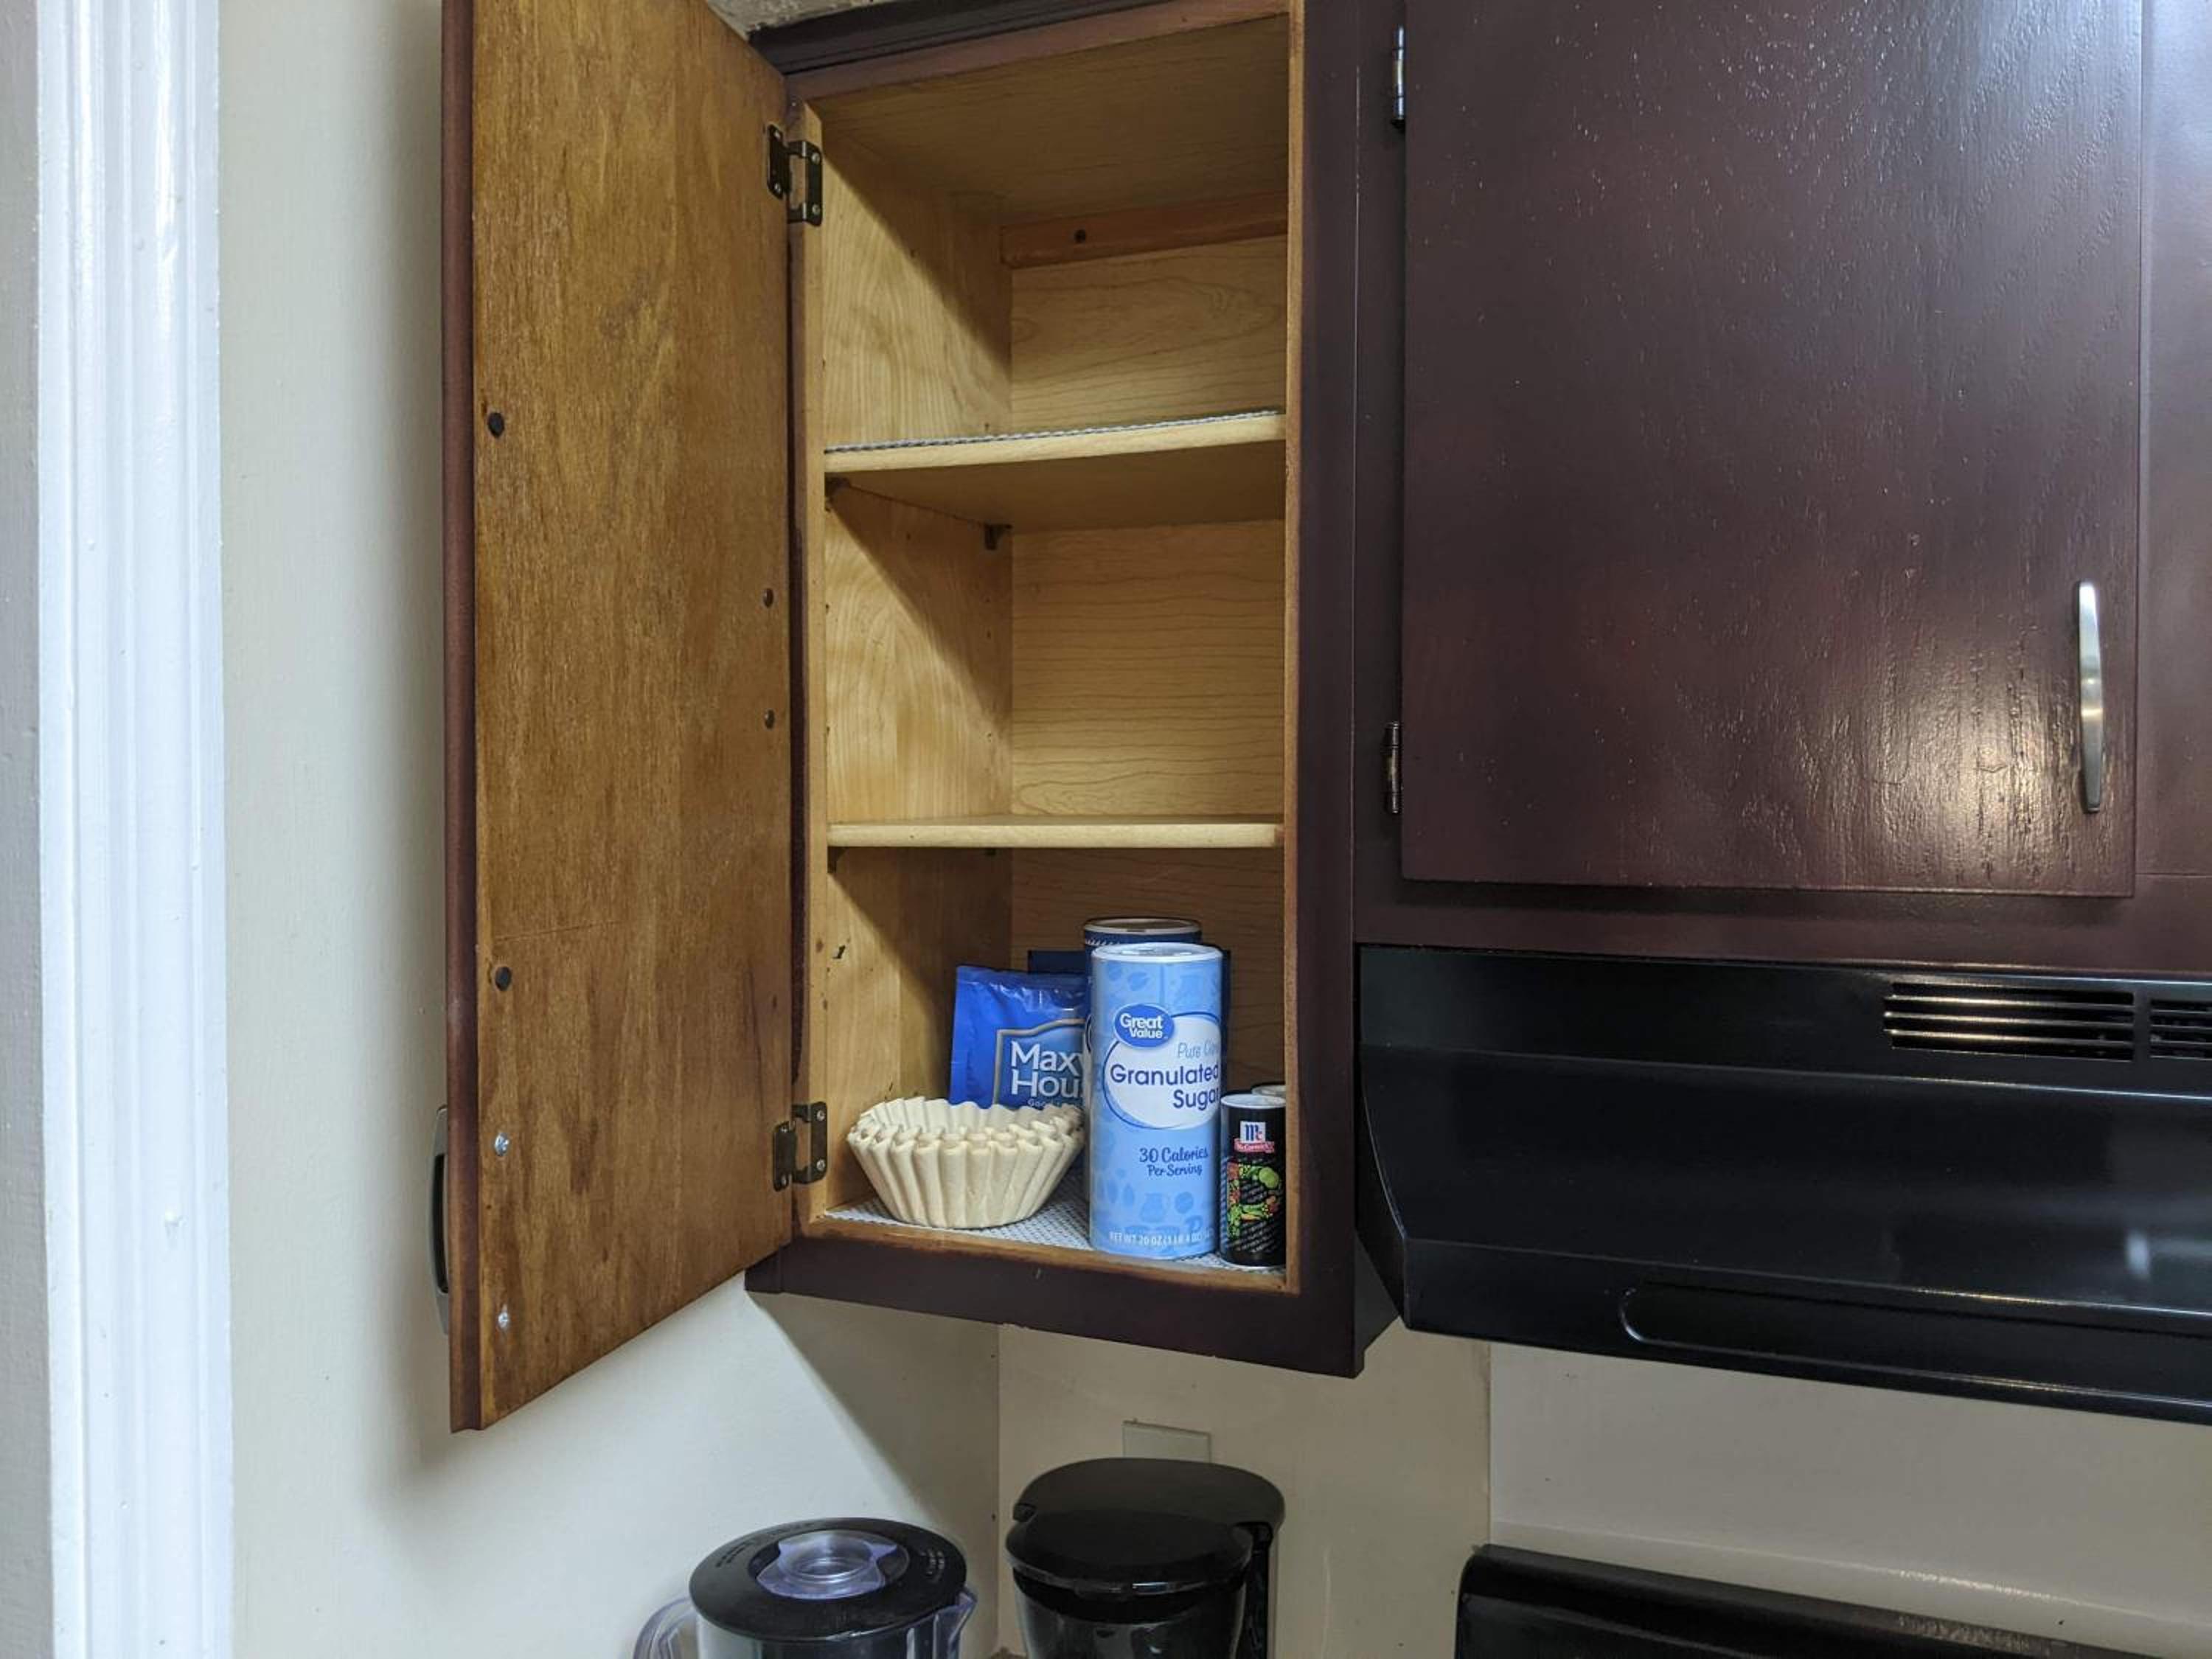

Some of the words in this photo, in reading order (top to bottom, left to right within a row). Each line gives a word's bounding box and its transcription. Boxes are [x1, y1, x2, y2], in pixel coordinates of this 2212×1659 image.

[1119, 1013, 1163, 1029] Great
[1130, 1027, 1163, 1039] Value
[1178, 1042, 1200, 1059] Pure
[1011, 1068, 1082, 1097] Hou
[1139, 1147, 1159, 1163] 30
[1161, 1146, 1209, 1164] Calories
[1147, 1164, 1165, 1177] Per
[1166, 1163, 1203, 1177] Serving
